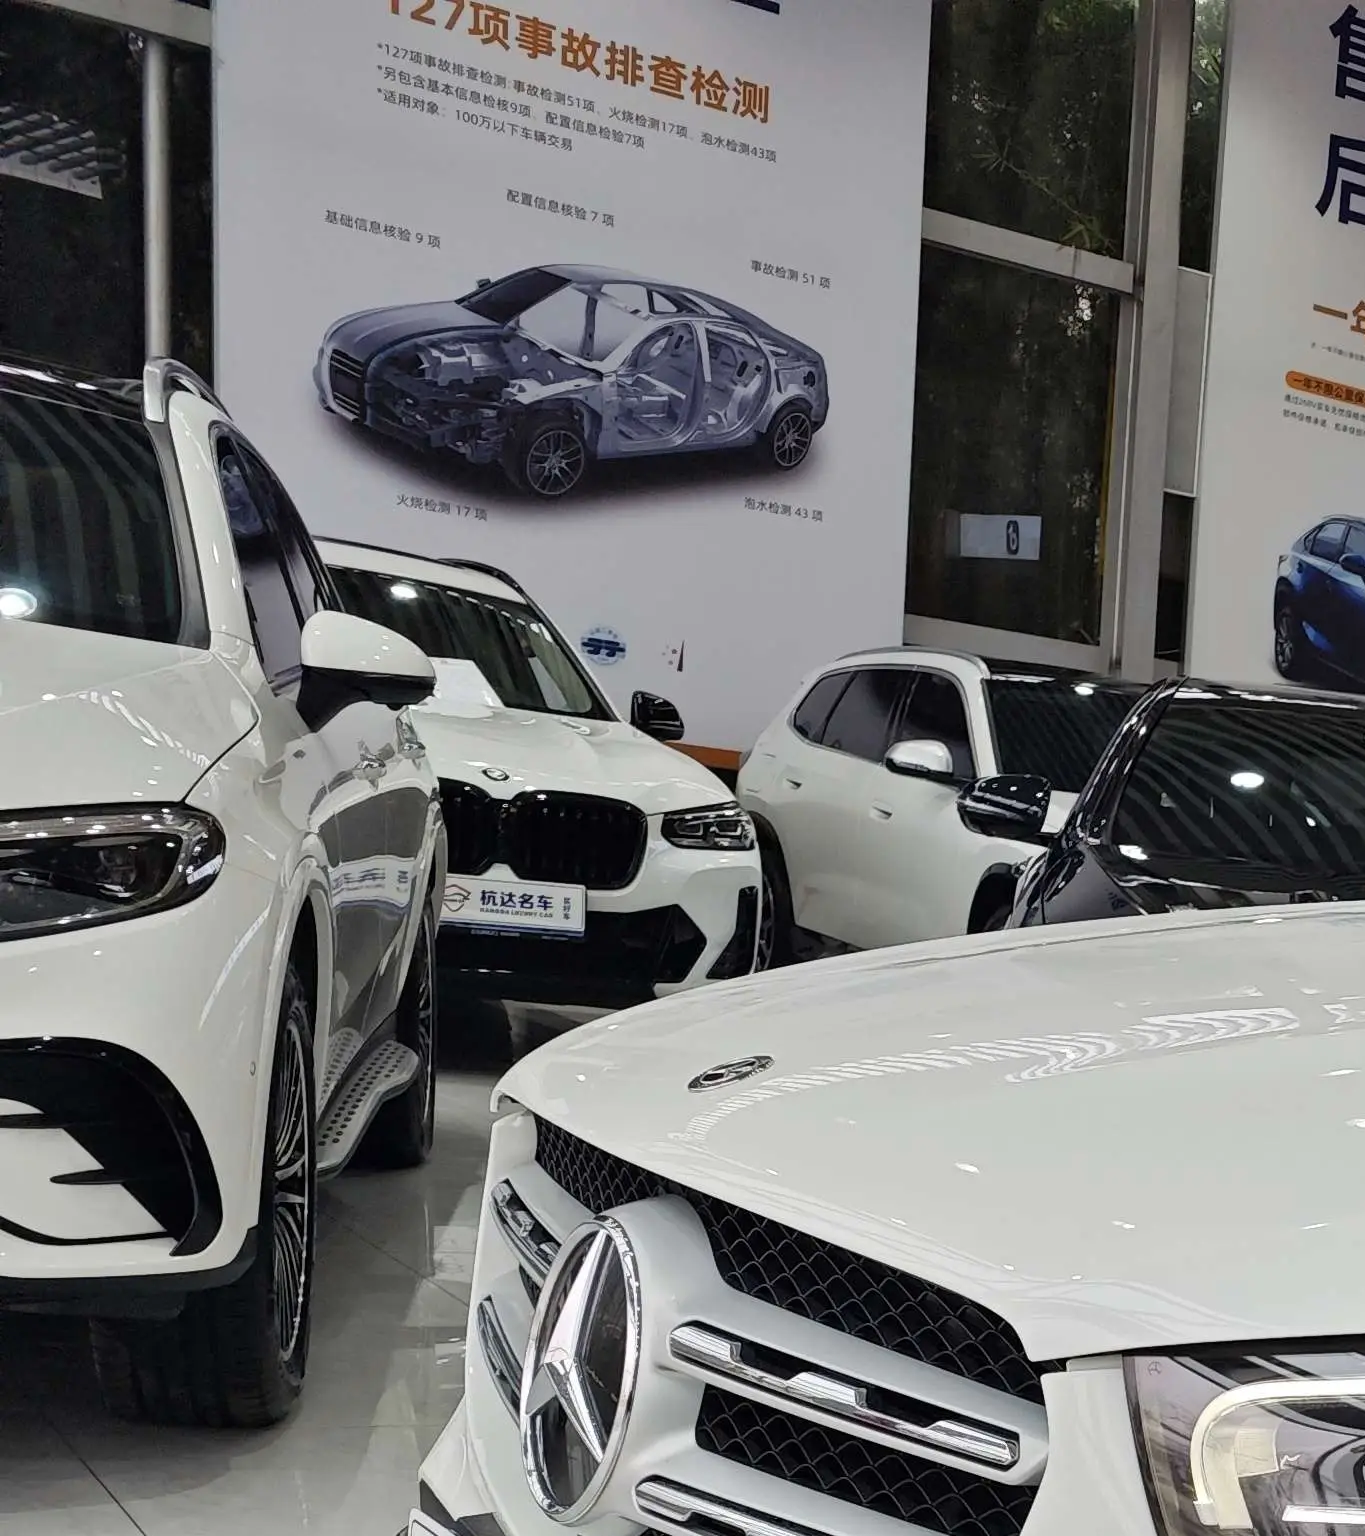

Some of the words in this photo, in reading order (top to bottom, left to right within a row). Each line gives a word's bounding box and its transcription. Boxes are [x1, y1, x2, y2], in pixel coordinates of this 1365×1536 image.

[506, 189, 587, 221] 配置信息核验
[591, 211, 598, 222] 7
[602, 213, 615, 228] 项
[324, 209, 411, 242] 基础信息核验
[415, 232, 424, 244] 9
[428, 234, 441, 249] 项
[751, 259, 799, 282] 事故检测
[802, 273, 815, 285] 51
[819, 276, 831, 289] 项
[396, 494, 450, 515] 火烧检测
[456, 504, 470, 517] 17
[474, 508, 487, 521] 项
[744, 496, 792, 517] 泡水检测
[795, 507, 809, 519] 43
[811, 509, 823, 522] 项
[480, 889, 554, 911] 杭达名车
